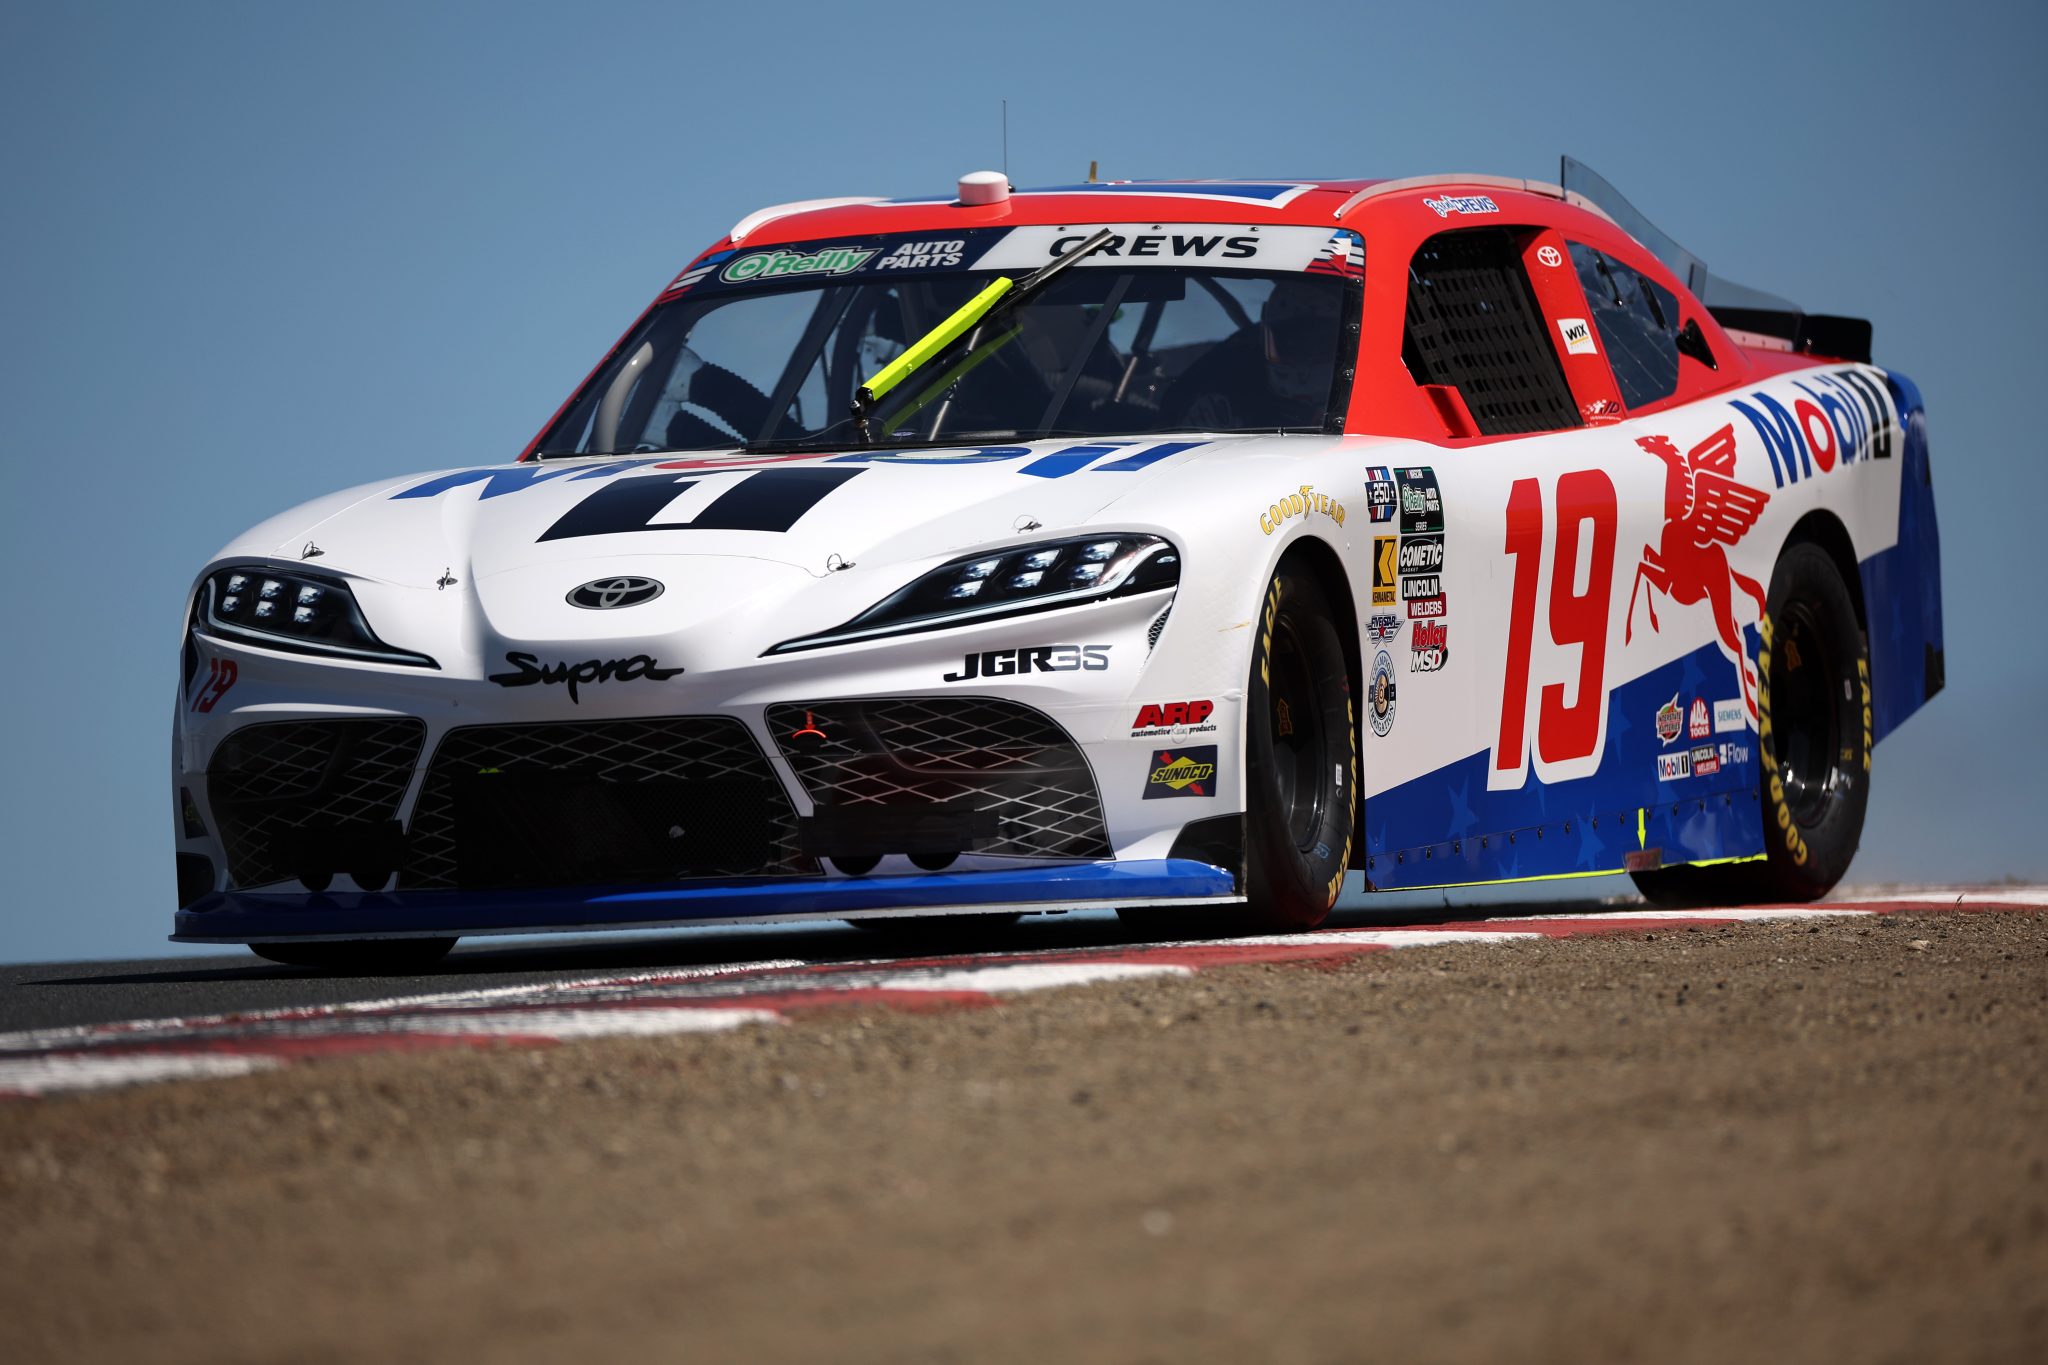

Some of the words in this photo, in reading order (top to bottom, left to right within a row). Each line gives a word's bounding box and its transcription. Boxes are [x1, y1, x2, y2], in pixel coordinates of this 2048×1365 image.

[1450, 197, 1498, 213] CREWS
[722, 248, 878, 281] O'Reilly
[894, 240, 965, 256] AUTO
[876, 253, 963, 270] PARTS
[1565, 324, 1587, 341] WIX
[1728, 374, 1869, 489] Mobil
[1843, 372, 1888, 454] 1
[646, 470, 763, 526] 1
[1373, 482, 1390, 505] 250
[1426, 499, 1440, 512] PARTS
[1400, 543, 1443, 567] COMETIC
[1403, 578, 1438, 598] LINCOLN
[1410, 600, 1443, 617] WELDERS
[1496, 468, 1618, 771] 19
[1411, 620, 1448, 653] Holley
[1411, 650, 1446, 672] MSD
[190, 656, 239, 713] 19
[488, 651, 685, 705] Supra
[1132, 700, 1214, 729] ARP
[1690, 699, 1709, 726] MAC
[1717, 708, 1742, 722] SIEMENS
[1131, 728, 1171, 738] automotive
[1188, 724, 1217, 734] products
[1690, 724, 1710, 738] TOOLS
[1727, 742, 1749, 763] Flow
[1153, 765, 1212, 783] SUNOCO
[1659, 755, 1681, 779] Mobil
